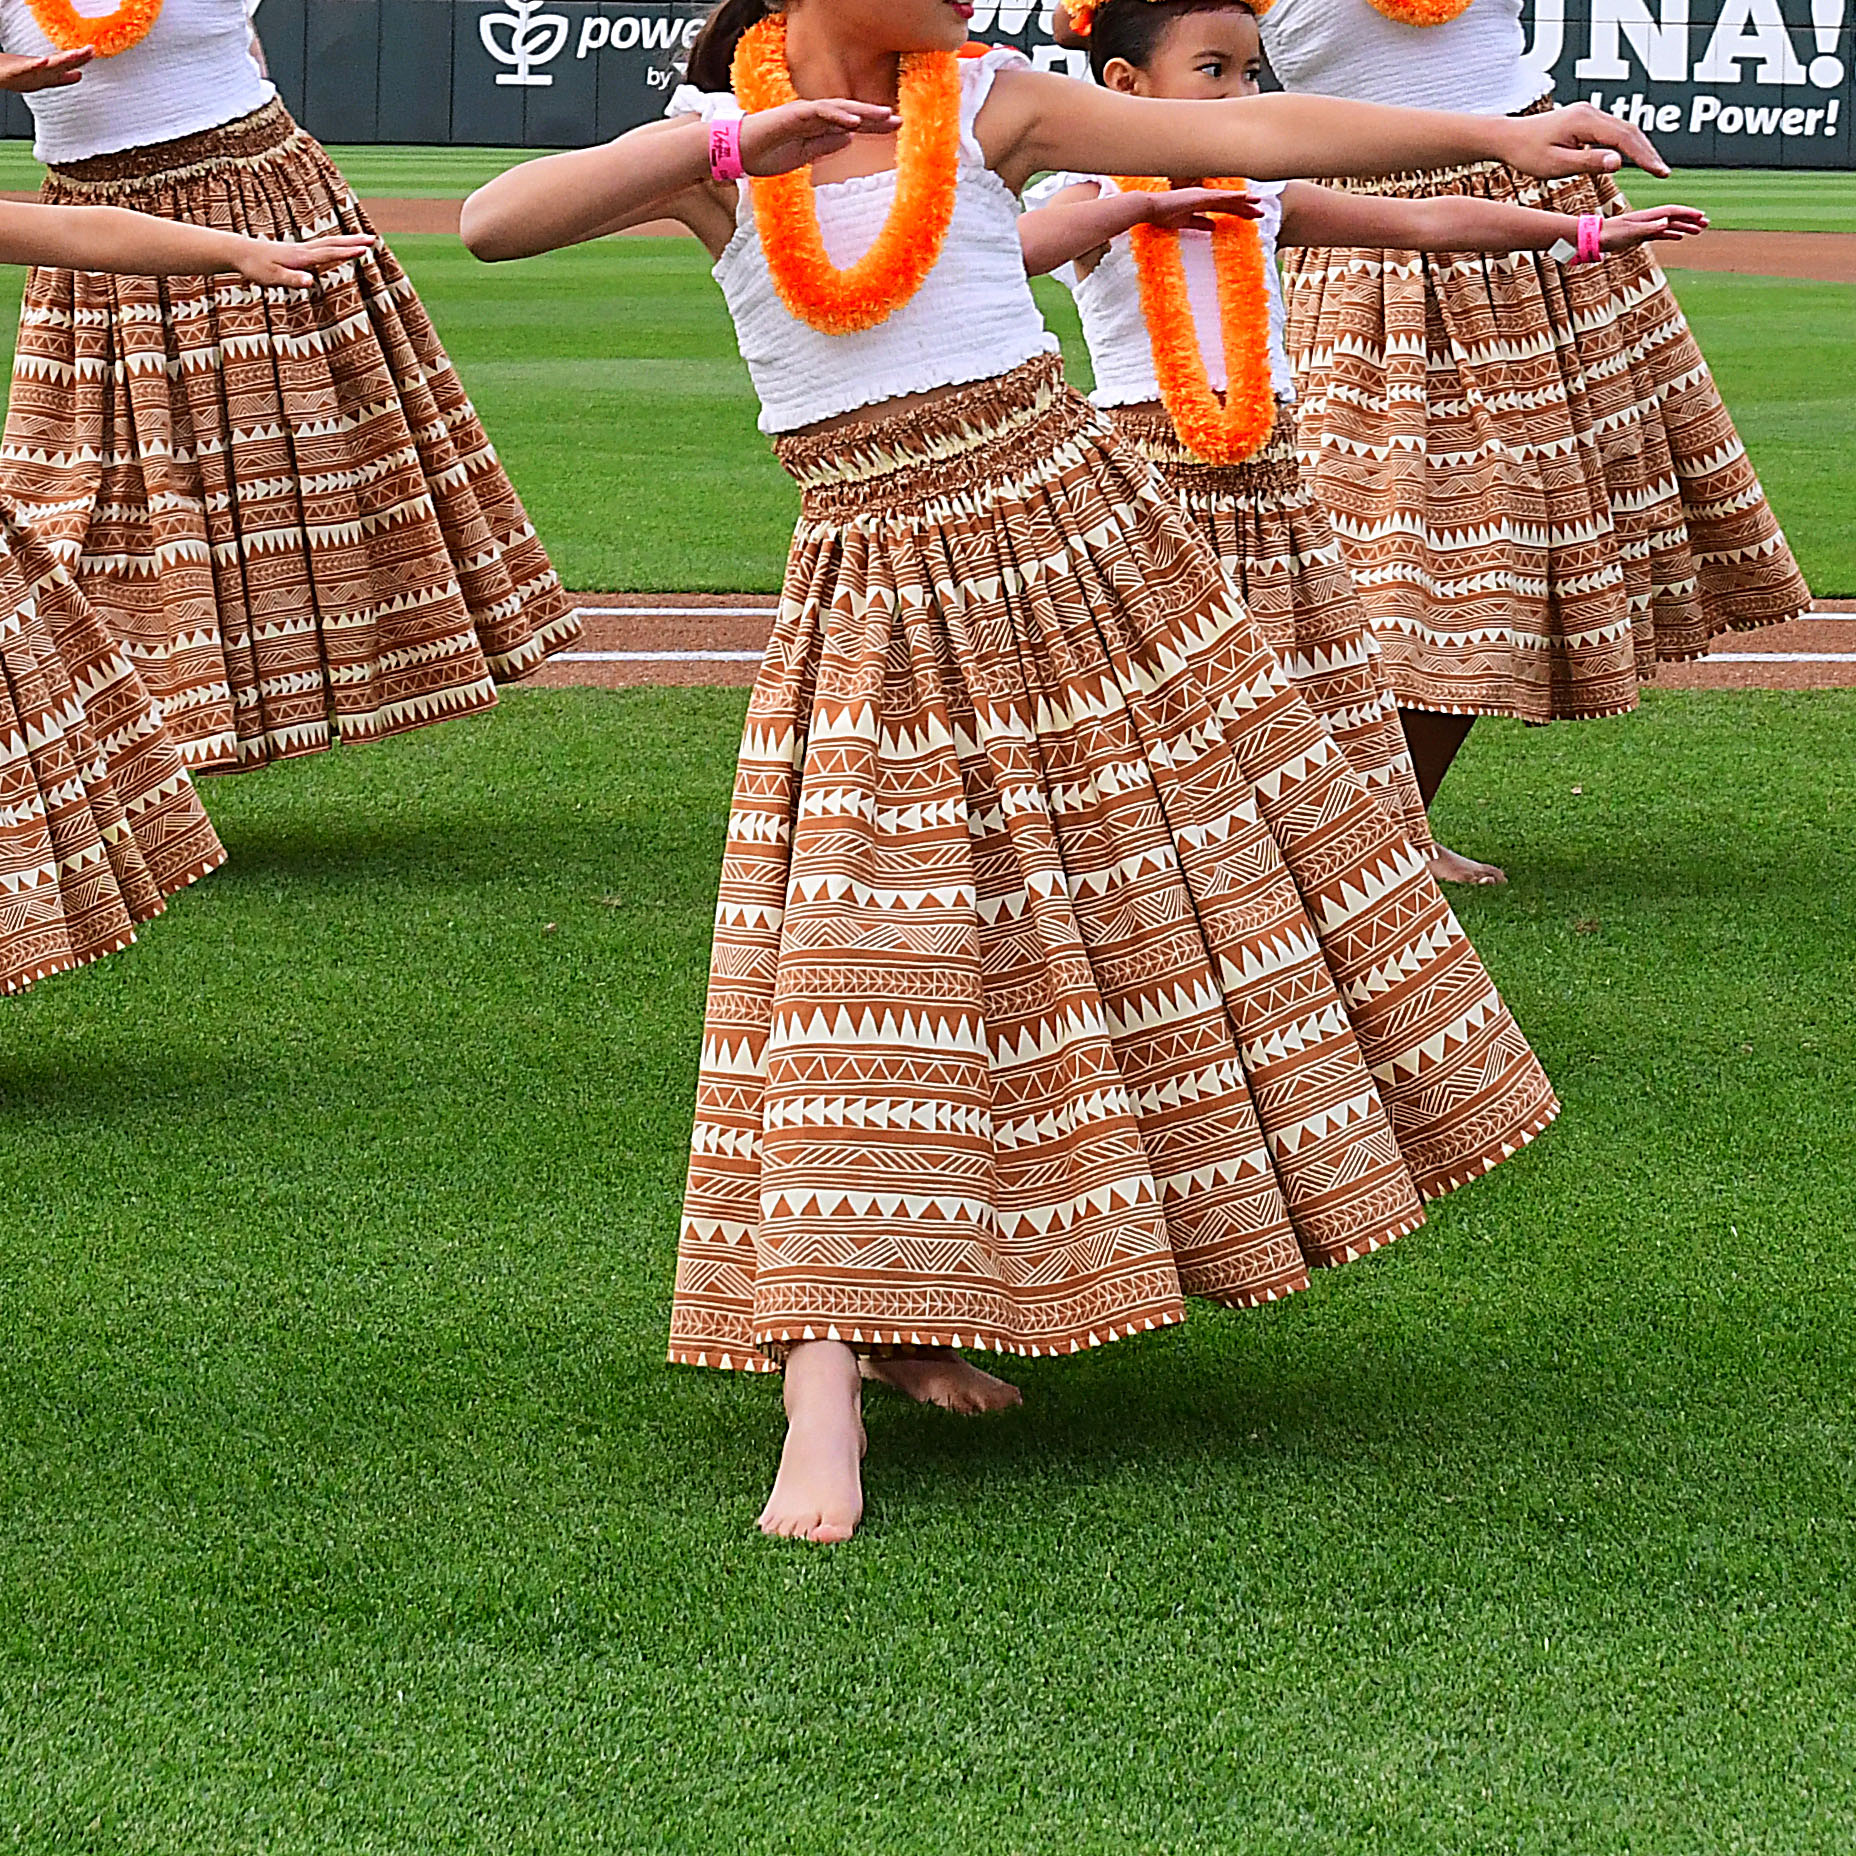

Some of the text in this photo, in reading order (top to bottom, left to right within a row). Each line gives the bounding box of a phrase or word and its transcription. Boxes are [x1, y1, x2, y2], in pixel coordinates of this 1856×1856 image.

[575, 15, 707, 59] powe
[646, 66, 674, 91] by
[1610, 92, 1681, 133] the
[1689, 95, 1840, 137] Power!
